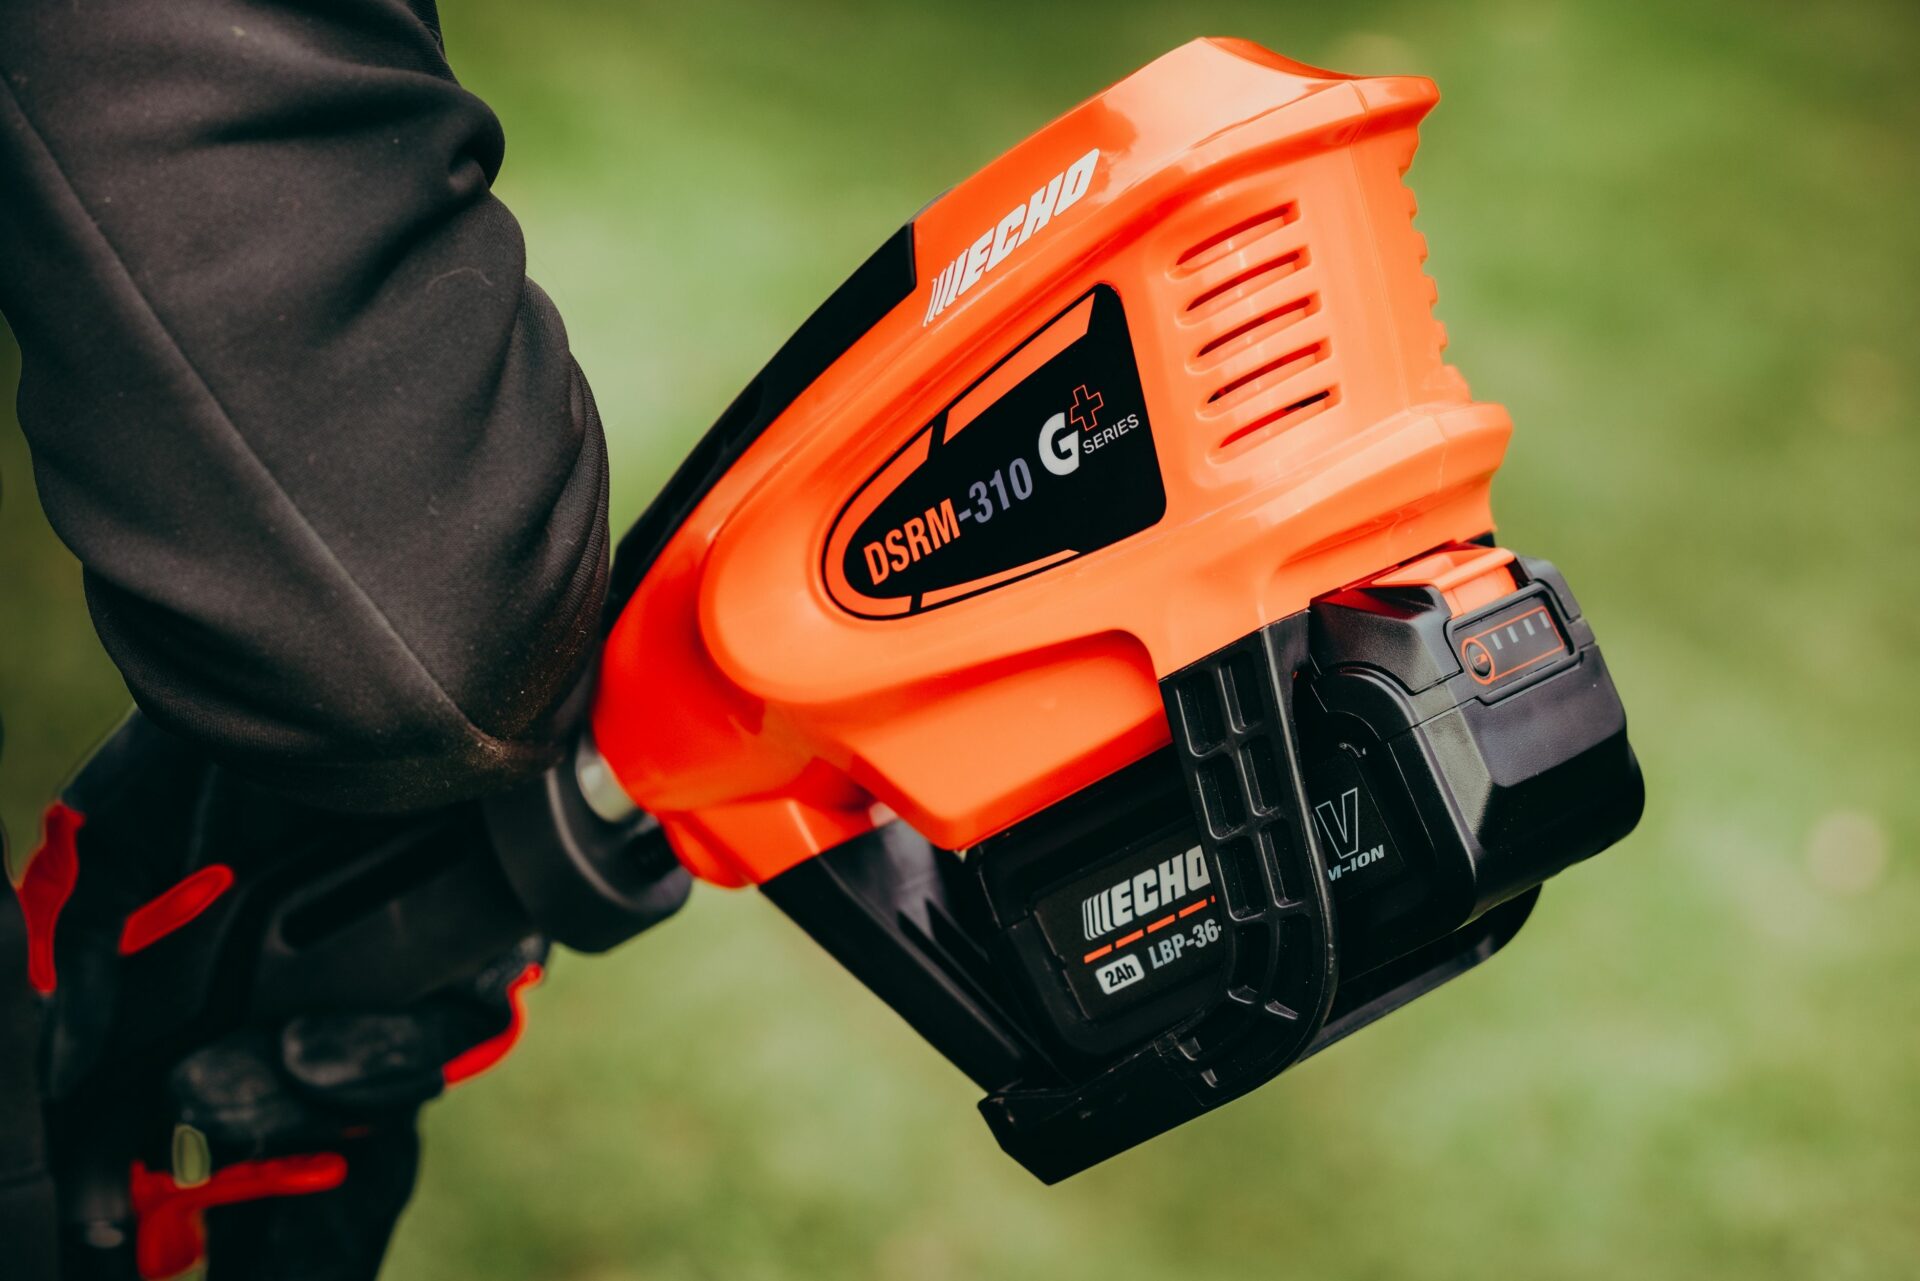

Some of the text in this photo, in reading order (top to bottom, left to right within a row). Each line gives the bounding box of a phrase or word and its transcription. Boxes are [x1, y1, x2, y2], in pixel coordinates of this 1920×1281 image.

[956, 147, 1100, 297] ECHO
[1082, 413, 1140, 455] SERIES
[863, 457, 1034, 586] DSRM-310
[1312, 787, 1359, 860] V
[1110, 844, 1212, 928] ECHO
[1104, 962, 1137, 988] 2Ah
